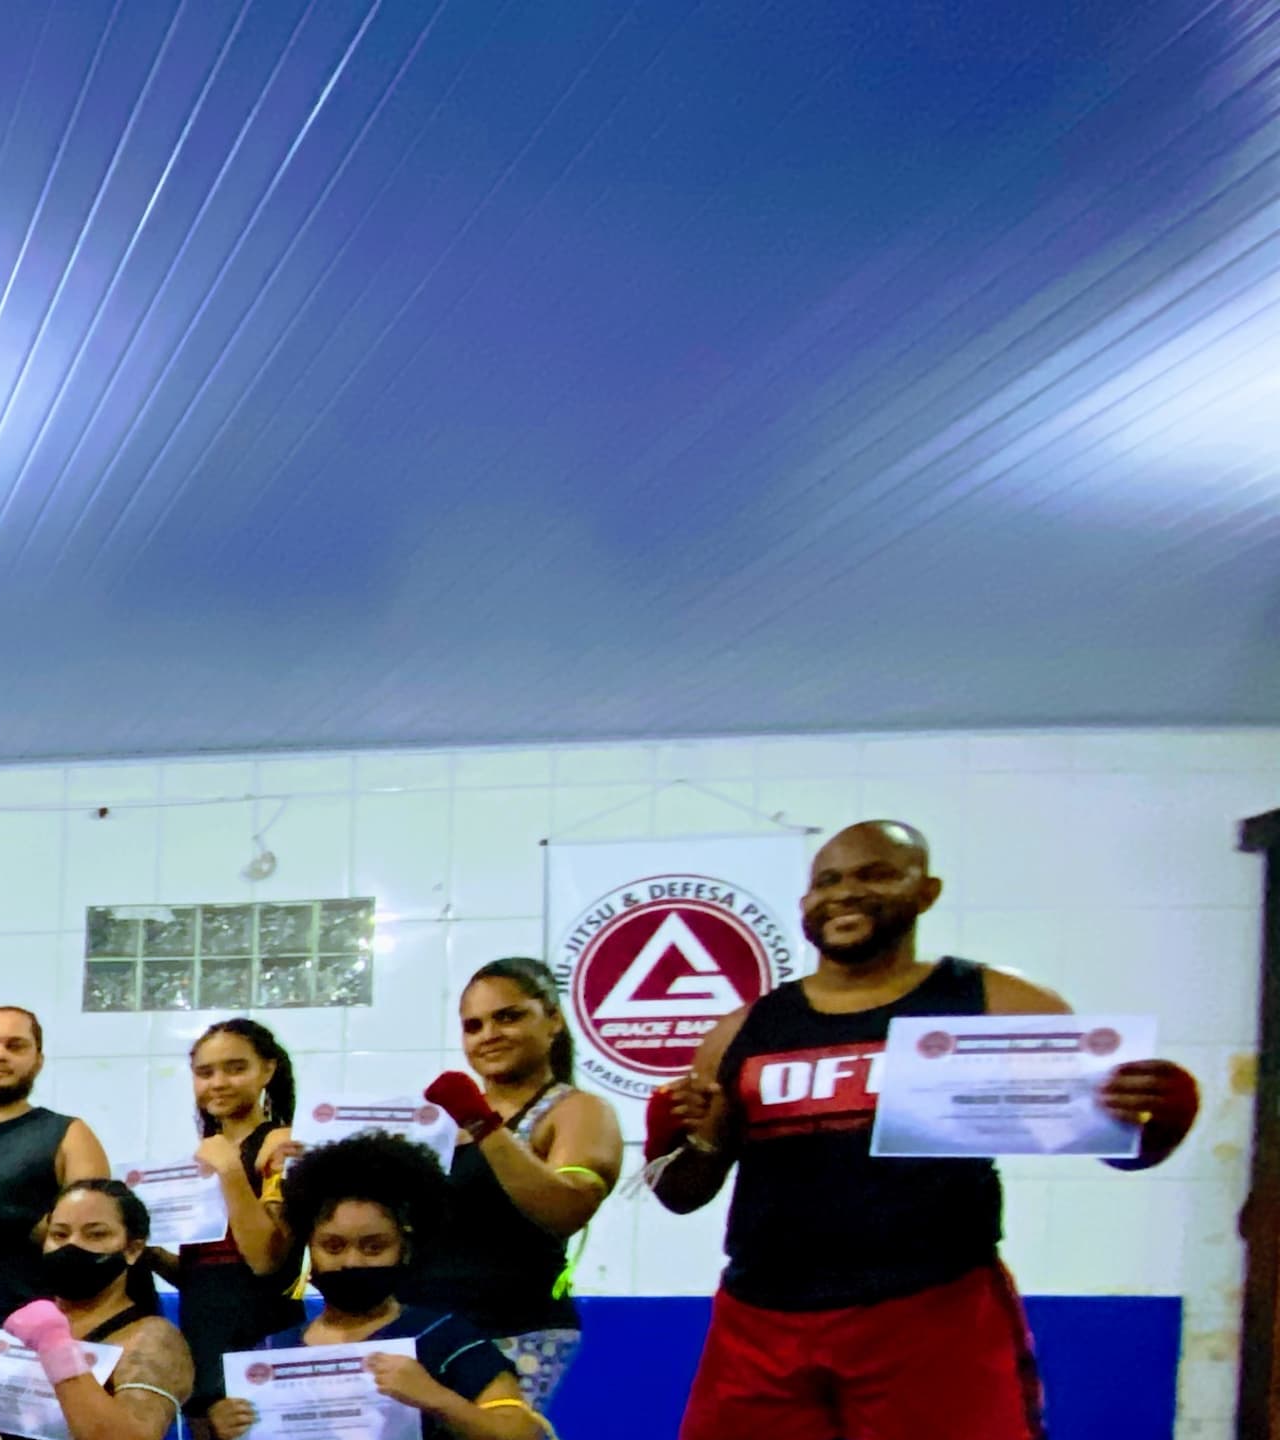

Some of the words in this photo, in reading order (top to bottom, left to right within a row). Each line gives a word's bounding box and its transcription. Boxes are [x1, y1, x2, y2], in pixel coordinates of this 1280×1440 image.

[622, 893, 640, 908] &
[648, 881, 735, 908] DEFESA
[741, 903, 794, 979] PESSOA
[582, 1059, 655, 1094] APARECI
[759, 1051, 888, 1106] DFT
